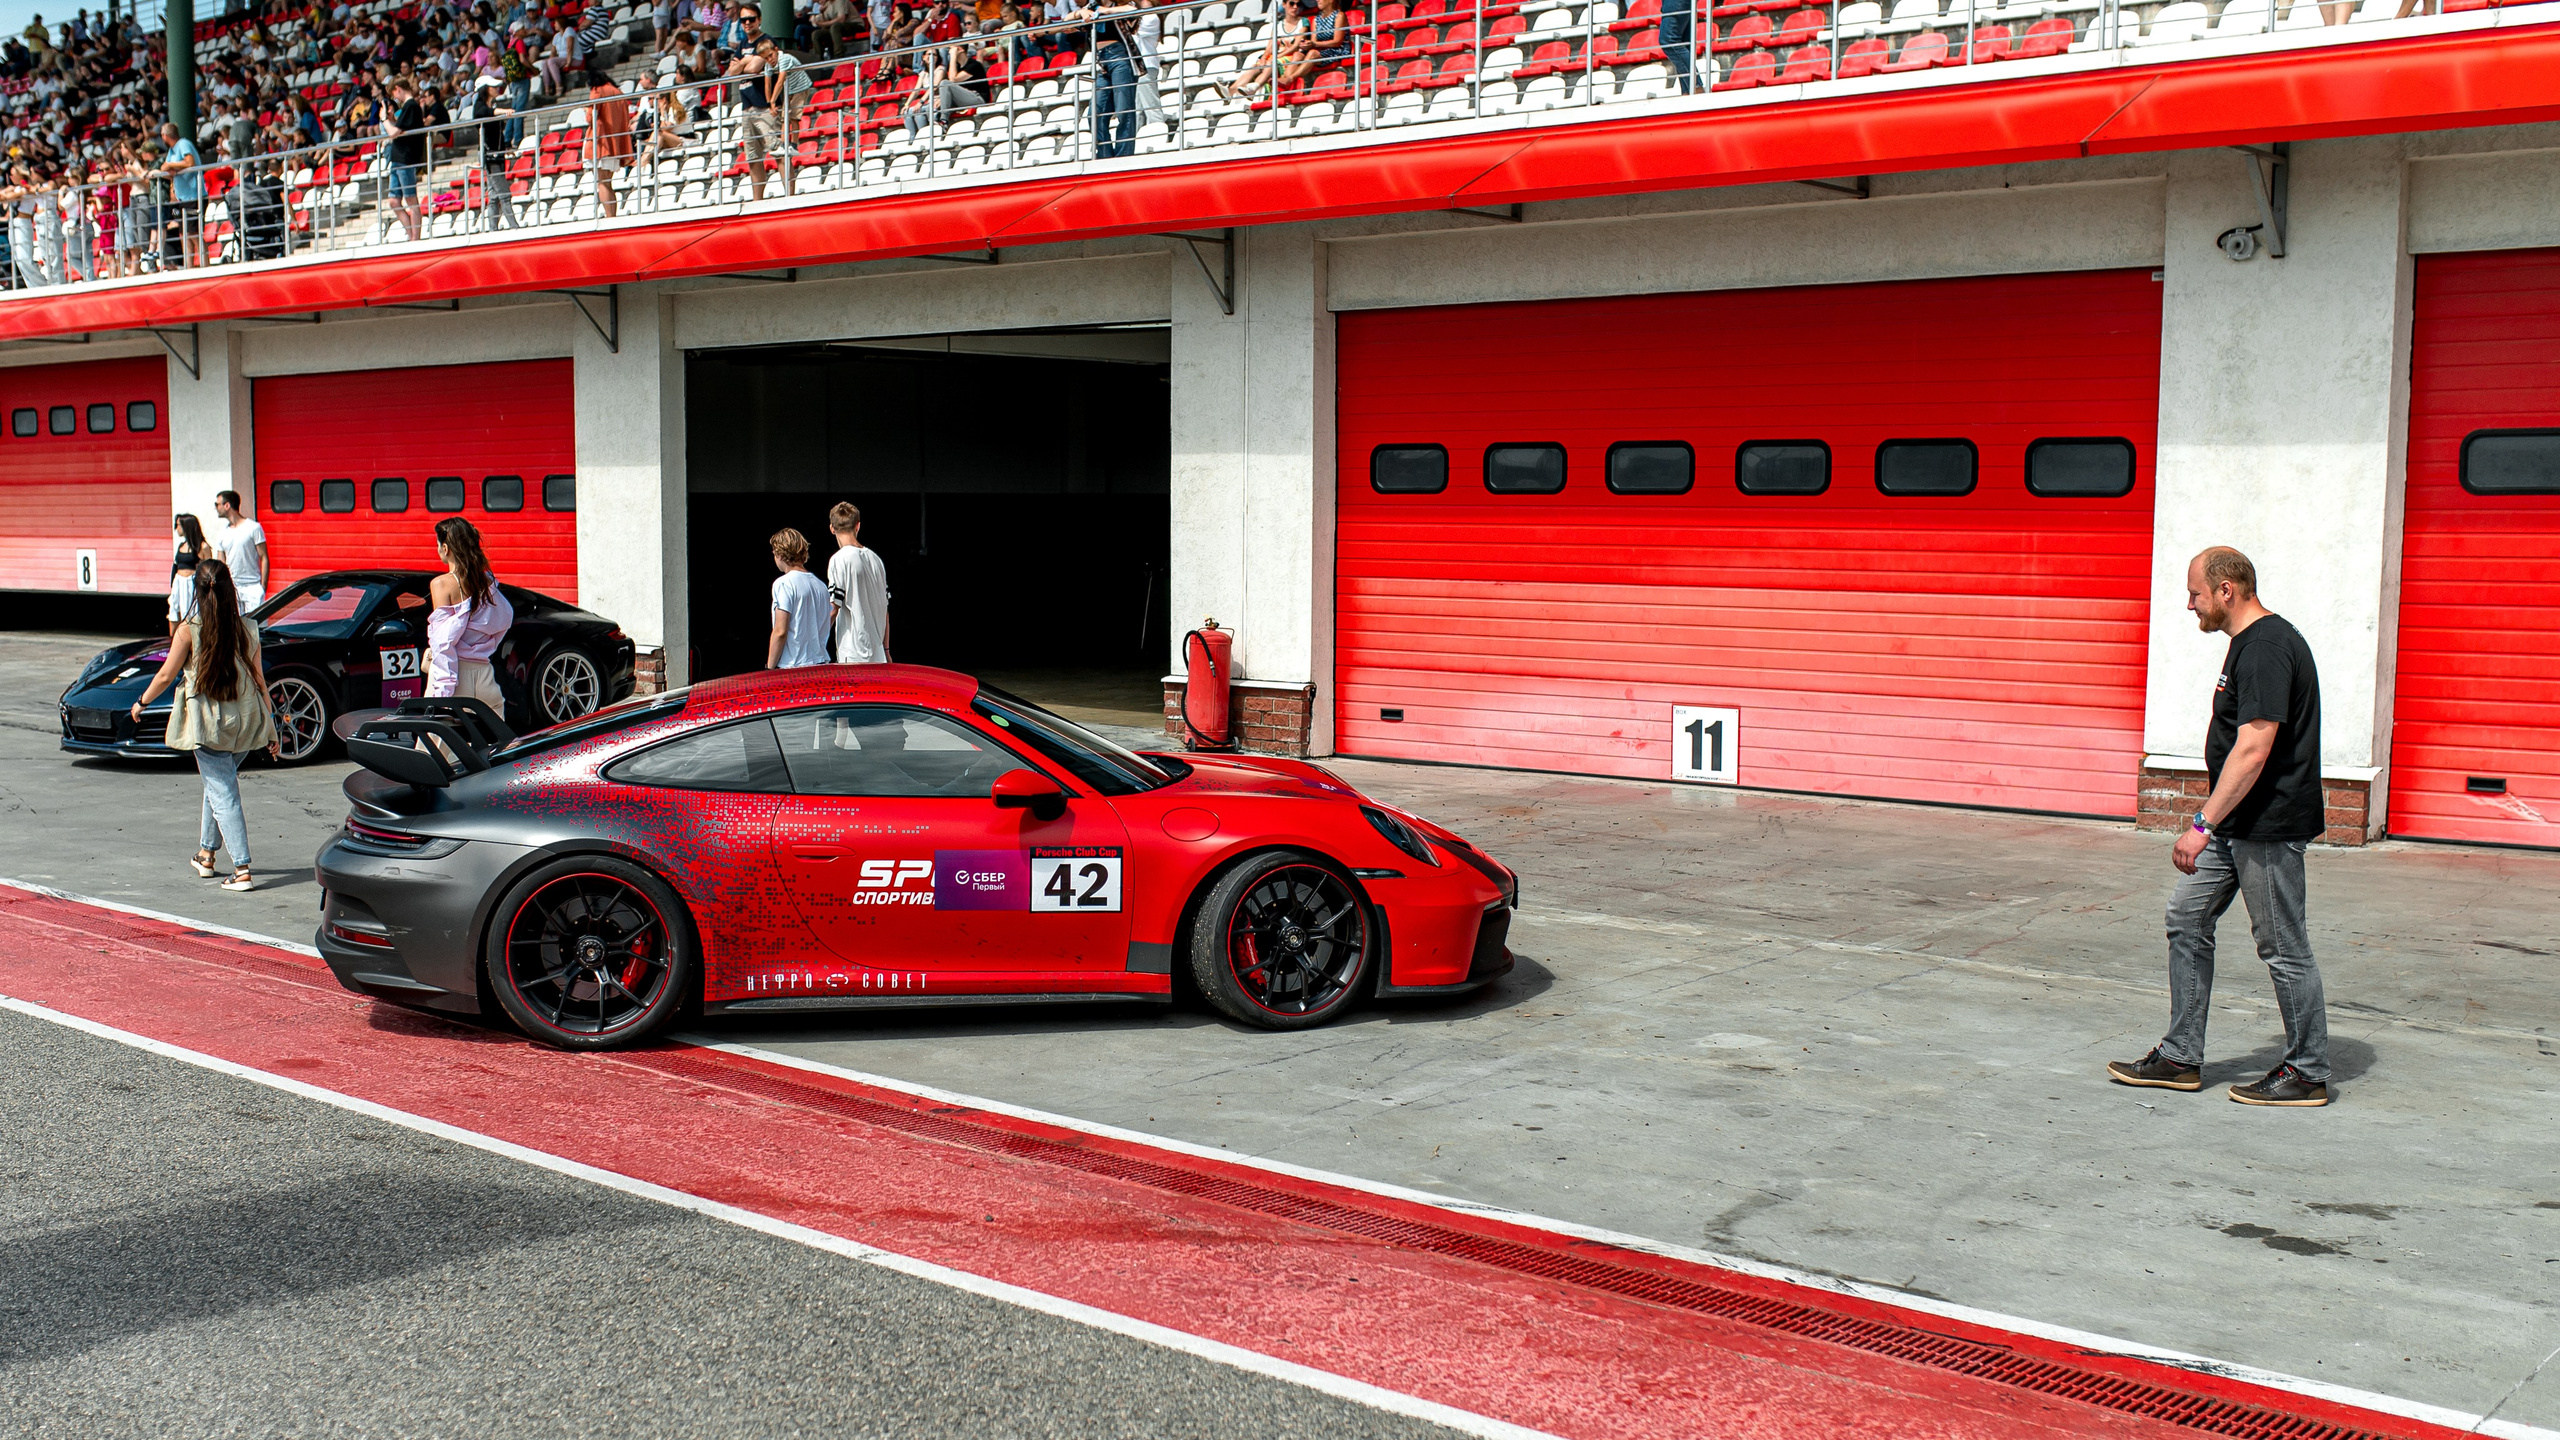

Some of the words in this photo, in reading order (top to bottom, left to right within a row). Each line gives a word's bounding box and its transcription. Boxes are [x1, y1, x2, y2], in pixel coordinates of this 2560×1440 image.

[82, 556, 91, 585] 8
[387, 651, 415, 676] 32
[1685, 719, 1723, 771] 11
[1035, 847, 1073, 857] Porsche
[1075, 847, 1096, 857] Club
[1098, 847, 1117, 858] Cup
[857, 860, 935, 887] SP
[972, 872, 1006, 882] СБЕР
[972, 882, 1005, 891] Первый
[1044, 863, 1108, 906] 42
[852, 891, 935, 905] СПОРТИВ
[747, 973, 812, 991] НЕФРО
[862, 973, 927, 989] СОВЕТ
